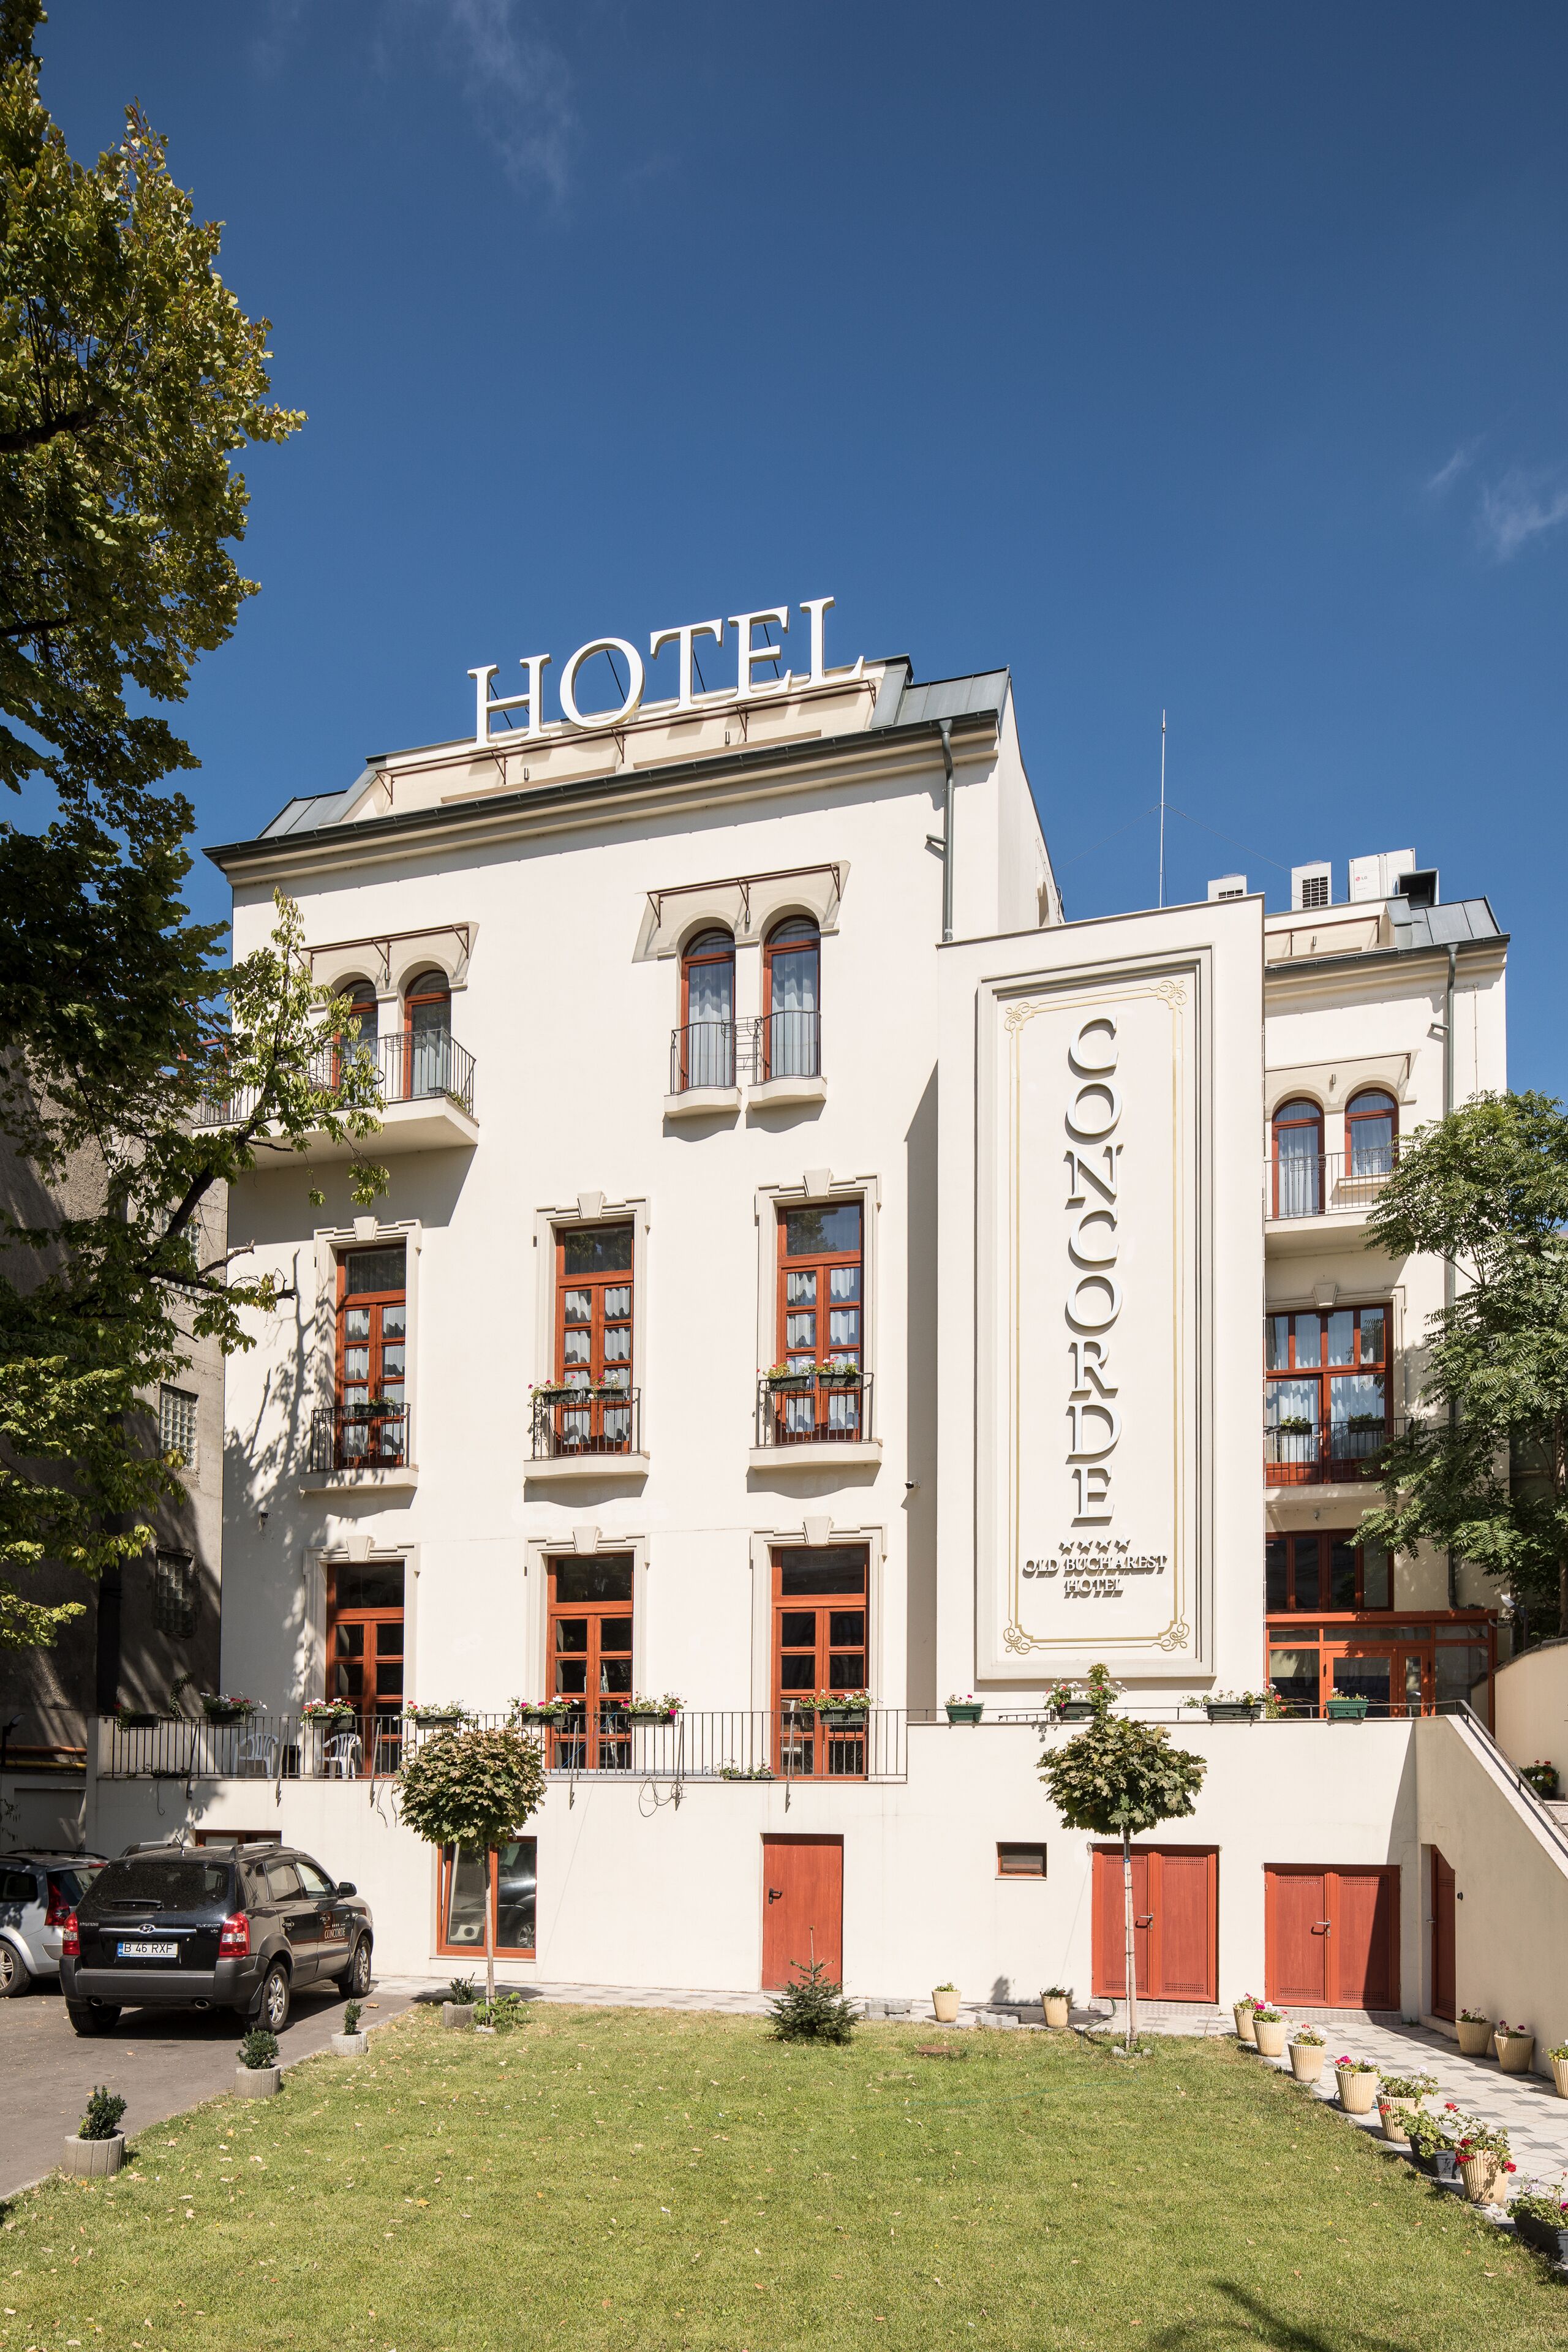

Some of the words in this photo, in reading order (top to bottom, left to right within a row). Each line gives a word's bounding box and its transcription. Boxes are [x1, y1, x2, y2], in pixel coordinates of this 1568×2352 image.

[467, 596, 865, 753] HOTEL
[1063, 1015, 1124, 1524] CONCORDE
[1023, 1559, 1060, 1574] OLD
[1065, 1554, 1168, 1574] BUCHAREST
[1065, 1578, 1125, 1594] HOTEL
[324, 1928, 345, 1939] CONCORDE
[124, 1943, 132, 1953] B
[135, 1943, 147, 1953] 46
[151, 1943, 174, 1953] RXF
